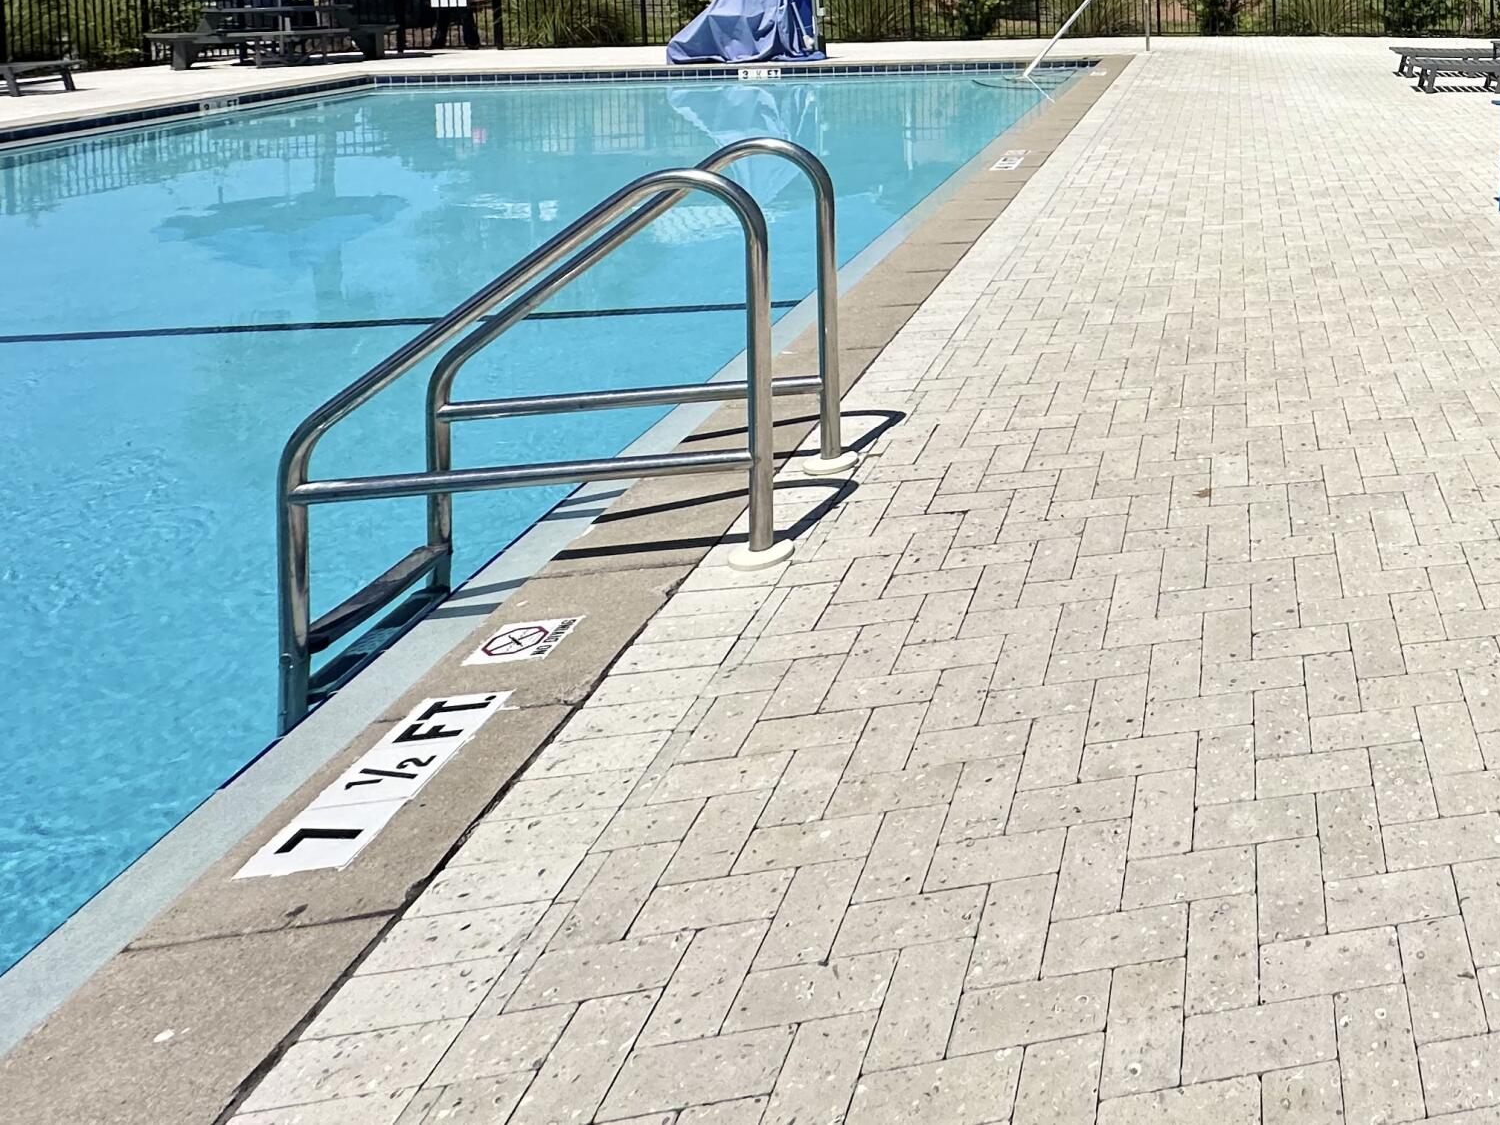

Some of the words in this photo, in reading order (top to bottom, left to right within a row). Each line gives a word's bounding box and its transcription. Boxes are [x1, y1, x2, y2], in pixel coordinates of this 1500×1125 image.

[530, 644, 552, 656] NO
[543, 619, 577, 643] DIVING
[274, 828, 363, 854] 7
